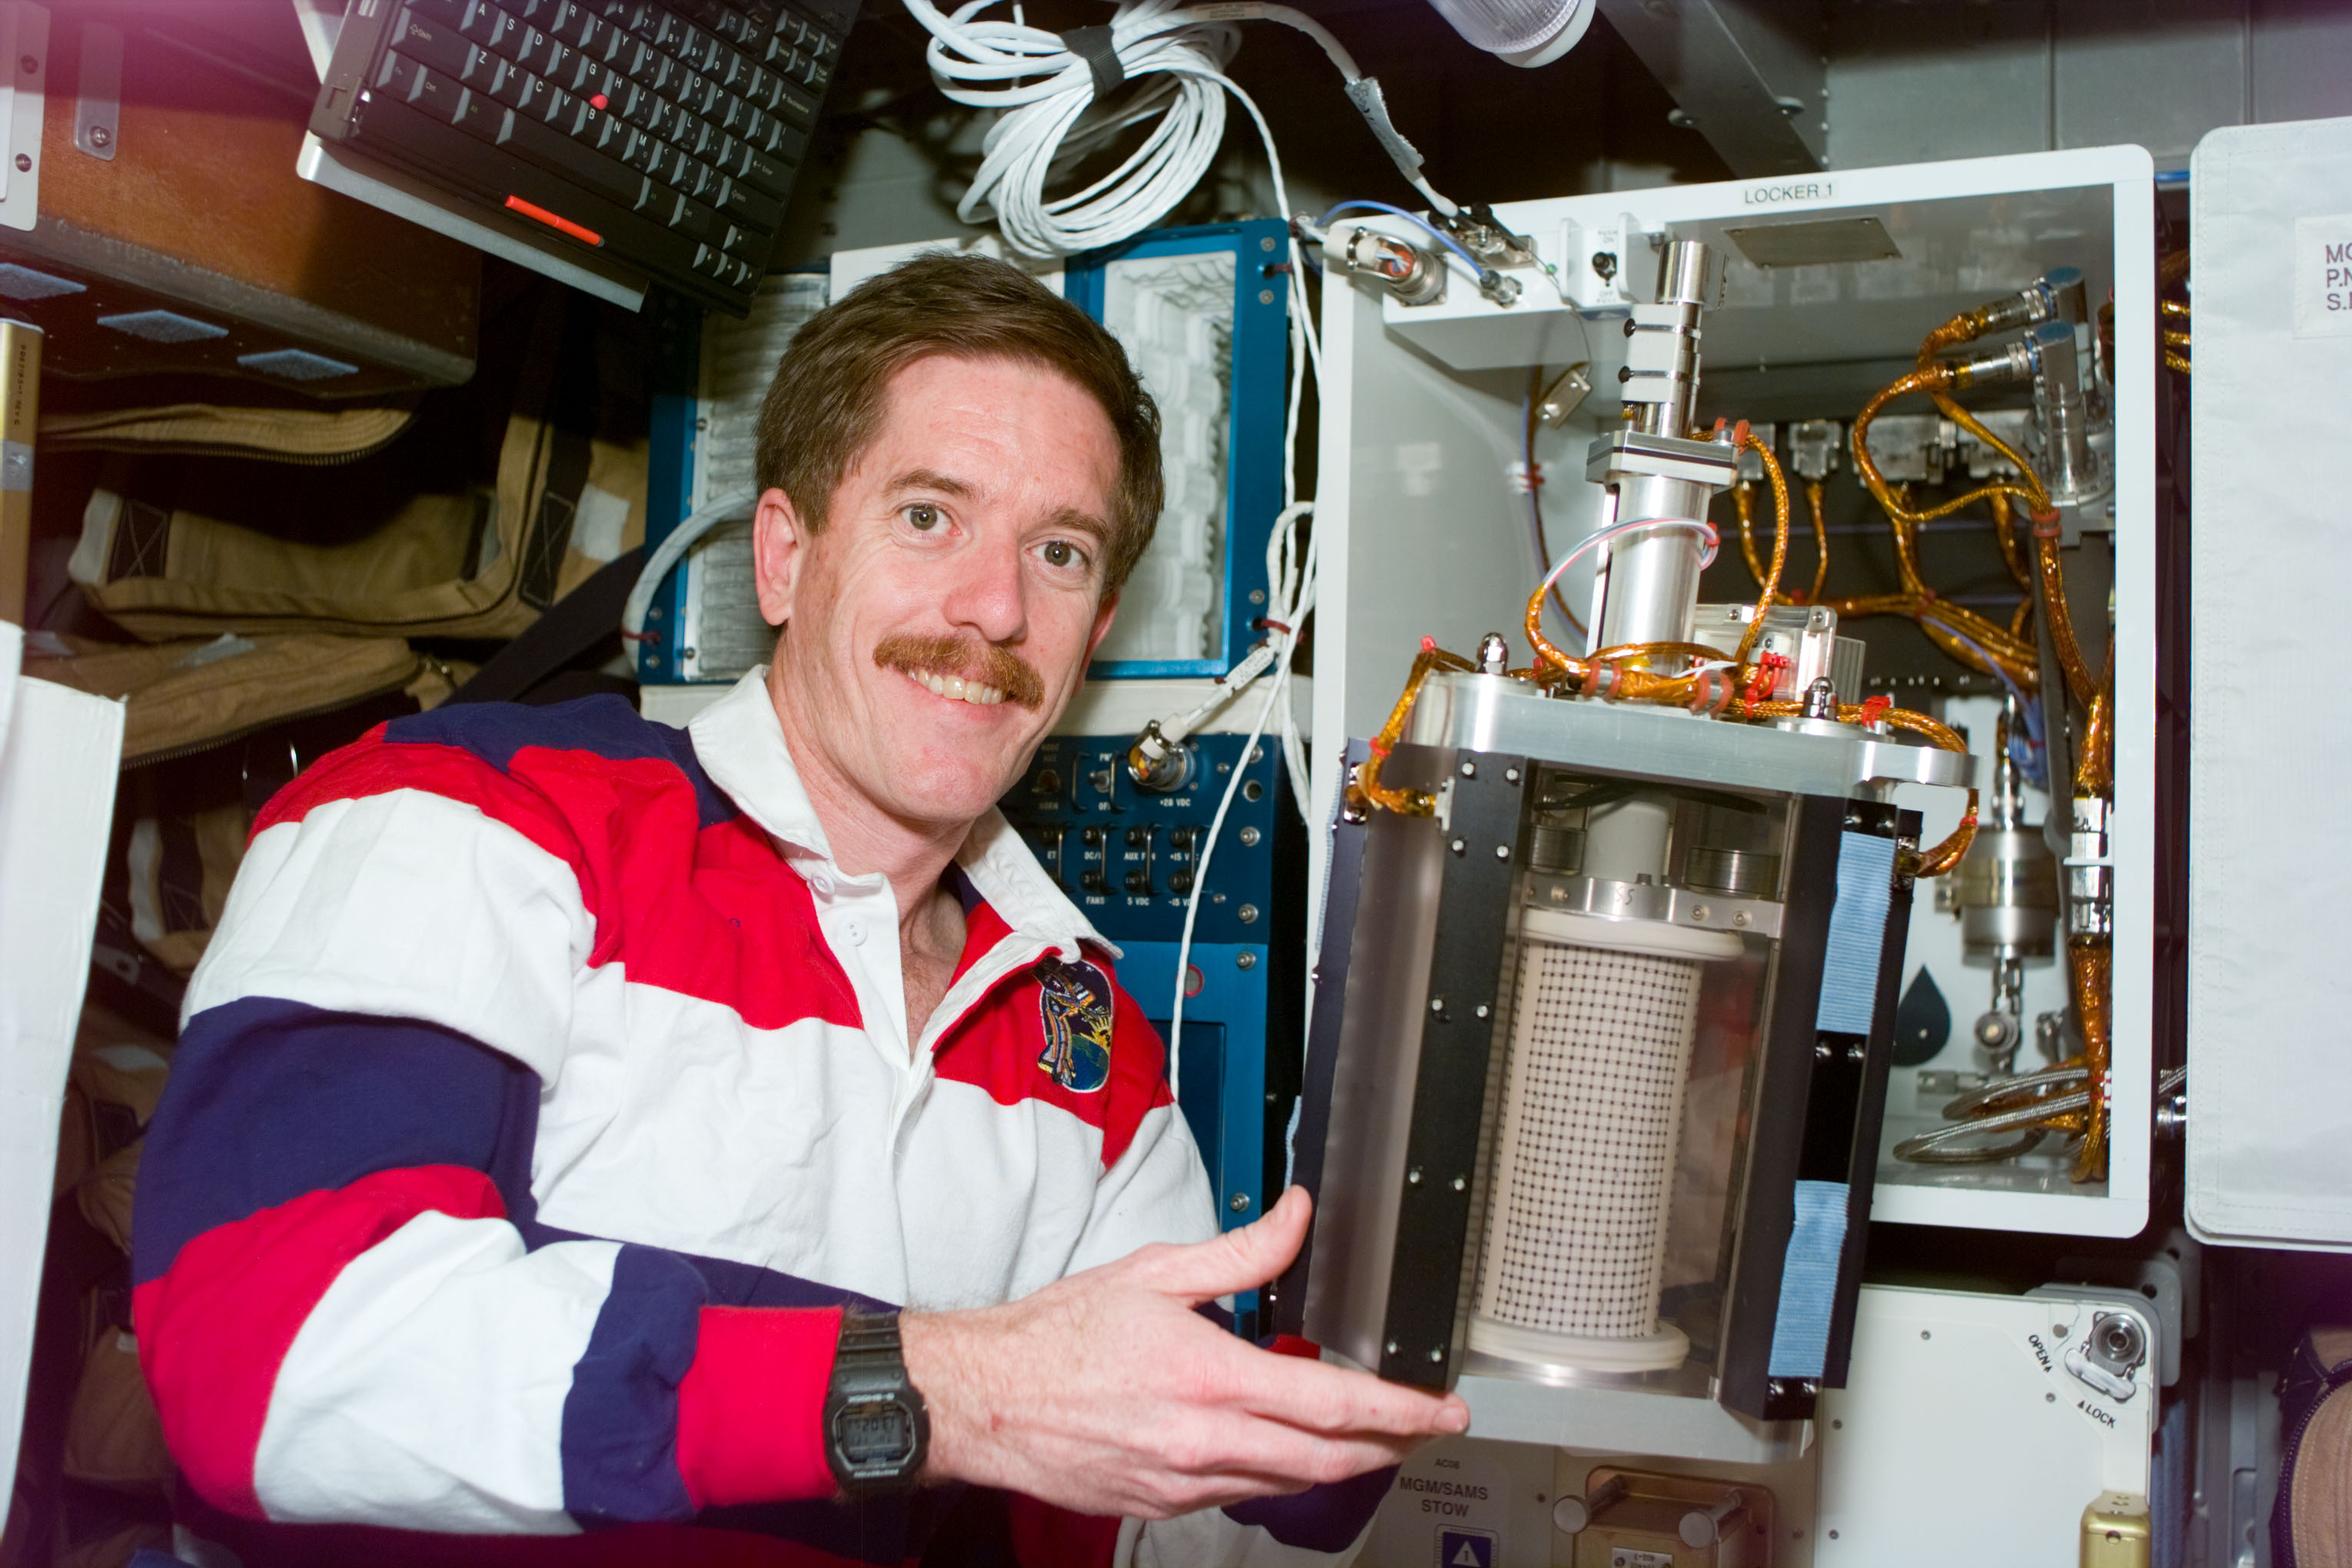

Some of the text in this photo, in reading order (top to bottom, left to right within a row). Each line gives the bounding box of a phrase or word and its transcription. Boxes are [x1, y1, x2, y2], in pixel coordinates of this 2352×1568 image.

[477, 3, 486, 15] A
[569, 5, 577, 17] R
[507, 18, 515, 31] S
[596, 20, 603, 32] T
[534, 34, 543, 45] D
[622, 35, 630, 46] Y
[479, 51, 488, 65] Z
[562, 48, 570, 59] F
[646, 48, 654, 61] U
[507, 65, 517, 78] X
[589, 63, 597, 75] G
[669, 62, 675, 74] I
[535, 80, 544, 92] C
[614, 76, 623, 89] H
[694, 76, 701, 88] O
[563, 95, 571, 106] V
[639, 91, 646, 102] J
[716, 89, 724, 101] P
[588, 108, 596, 121] B
[663, 103, 671, 116] K
[613, 121, 622, 134] N
[686, 116, 693, 128] L
[638, 135, 647, 147] M
[1745, 182, 1832, 204] LOCKER 1
[2327, 291, 2352, 311] S.
[1159, 798, 1191, 808] +28 VDC
[1124, 852, 1139, 861] AUX
[1085, 895, 1105, 905] FANS
[1134, 896, 1151, 906] VDC
[2028, 1334, 2051, 1365] OPEN
[2085, 1404, 2115, 1429] LOCK
[1400, 1477, 1489, 1500] MGM/SAMS
[1421, 1499, 1470, 1517] STOW
